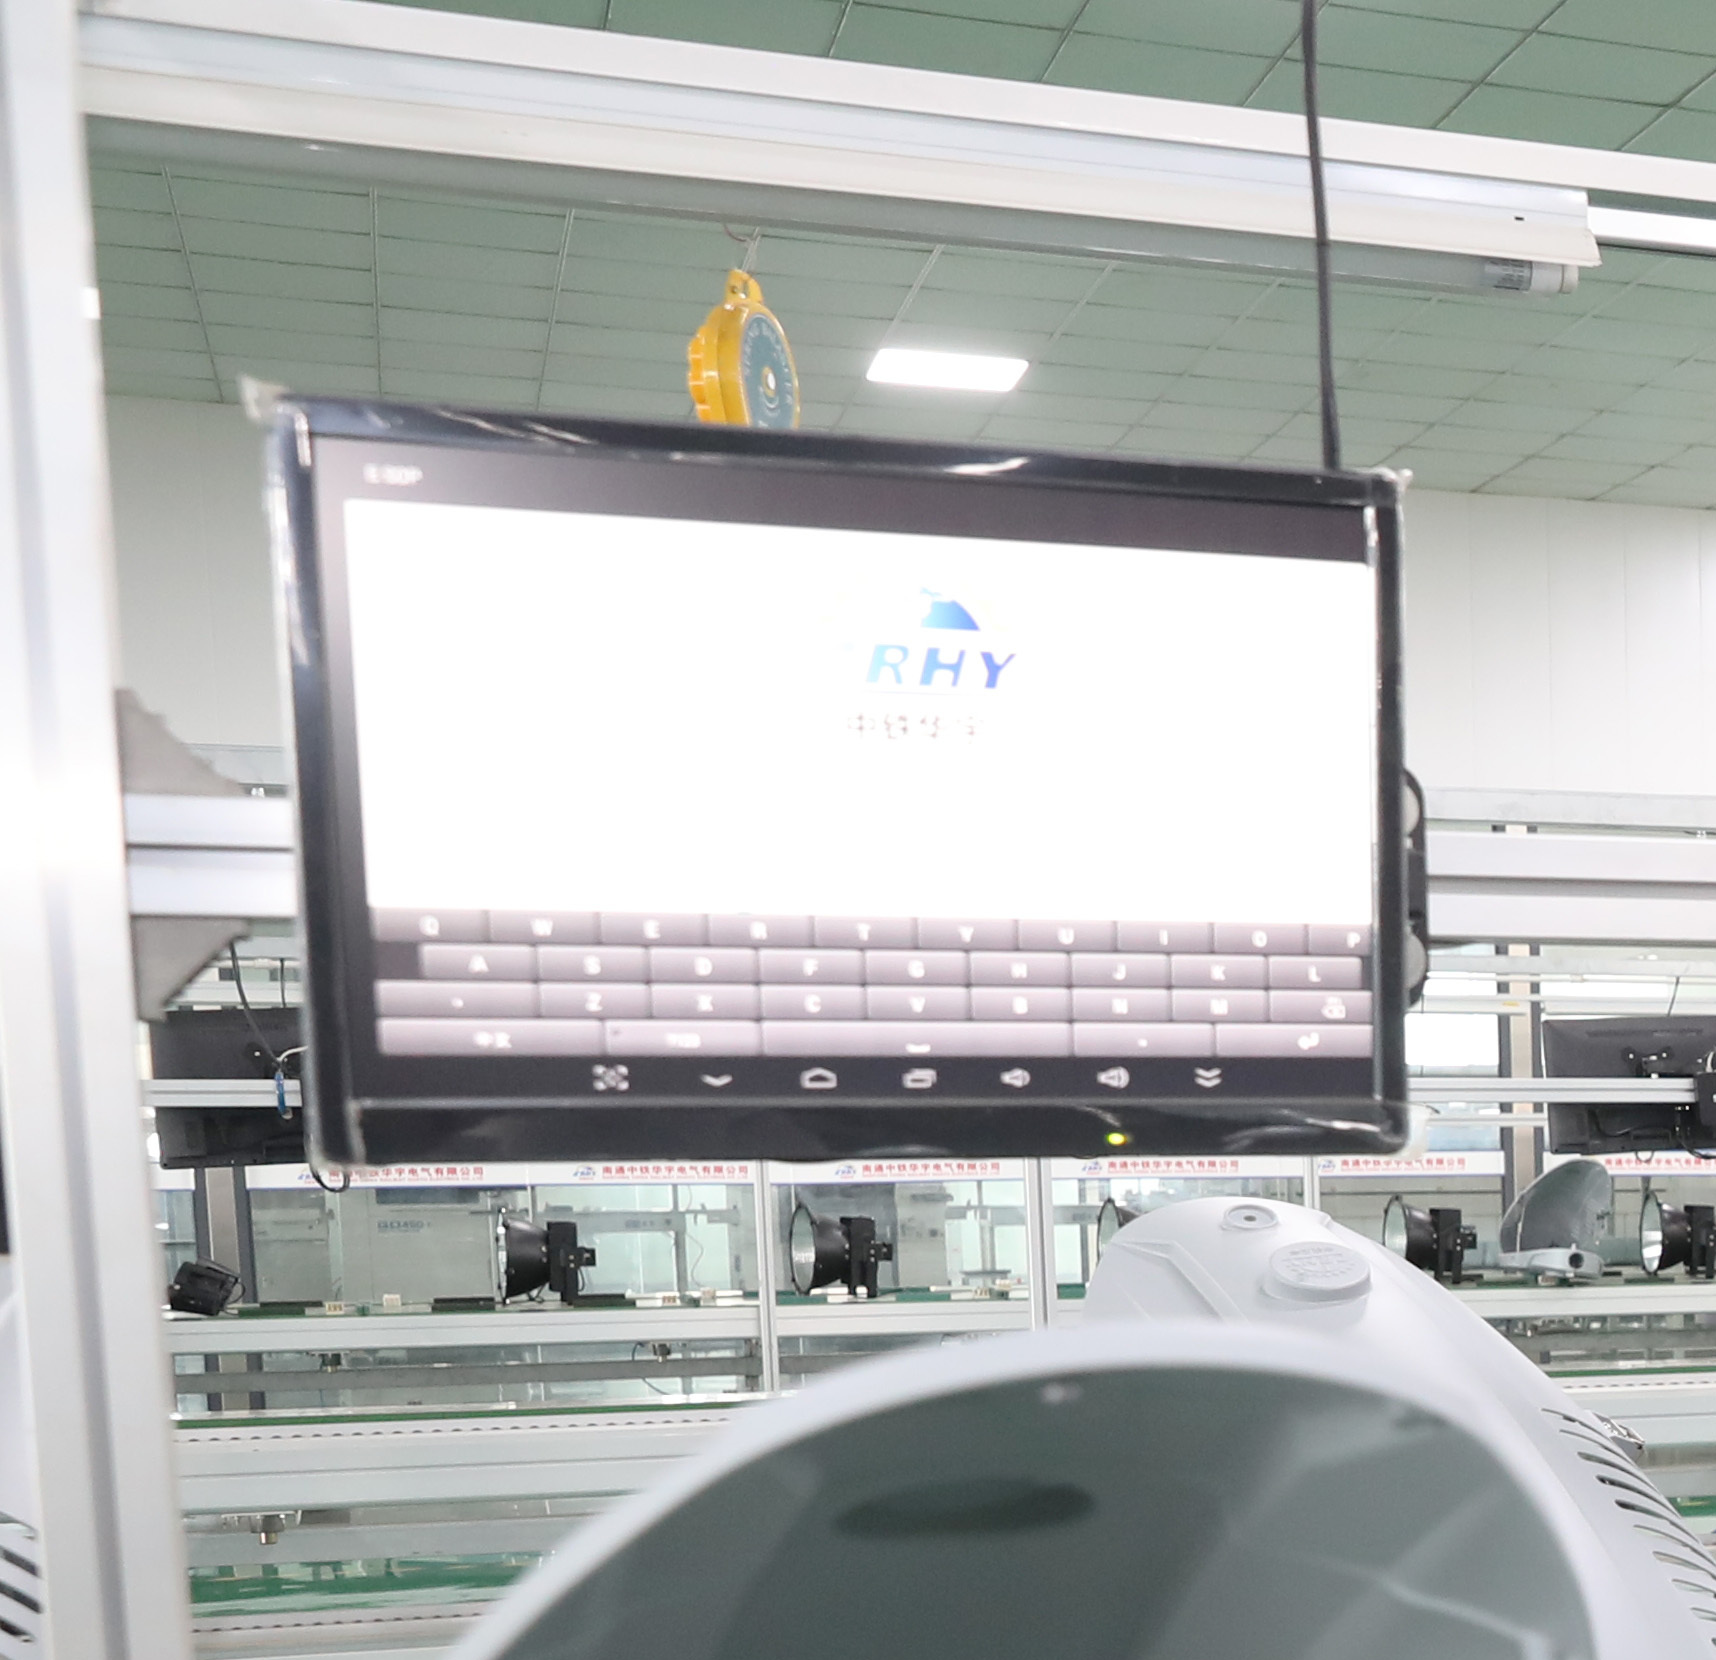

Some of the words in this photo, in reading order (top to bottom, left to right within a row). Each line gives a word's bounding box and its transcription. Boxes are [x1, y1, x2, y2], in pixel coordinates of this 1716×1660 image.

[420, 917, 440, 937] Q
[856, 923, 872, 942] T
[1058, 929, 1075, 945] U
[1159, 930, 1169, 946] I
[1346, 932, 1361, 949] P
[468, 956, 489, 973] A
[695, 957, 713, 976] D
[803, 959, 818, 976] F
[1113, 964, 1126, 981] J
[1210, 965, 1226, 981] K
[1308, 966, 1321, 983] L
[804, 995, 821, 1014] C
